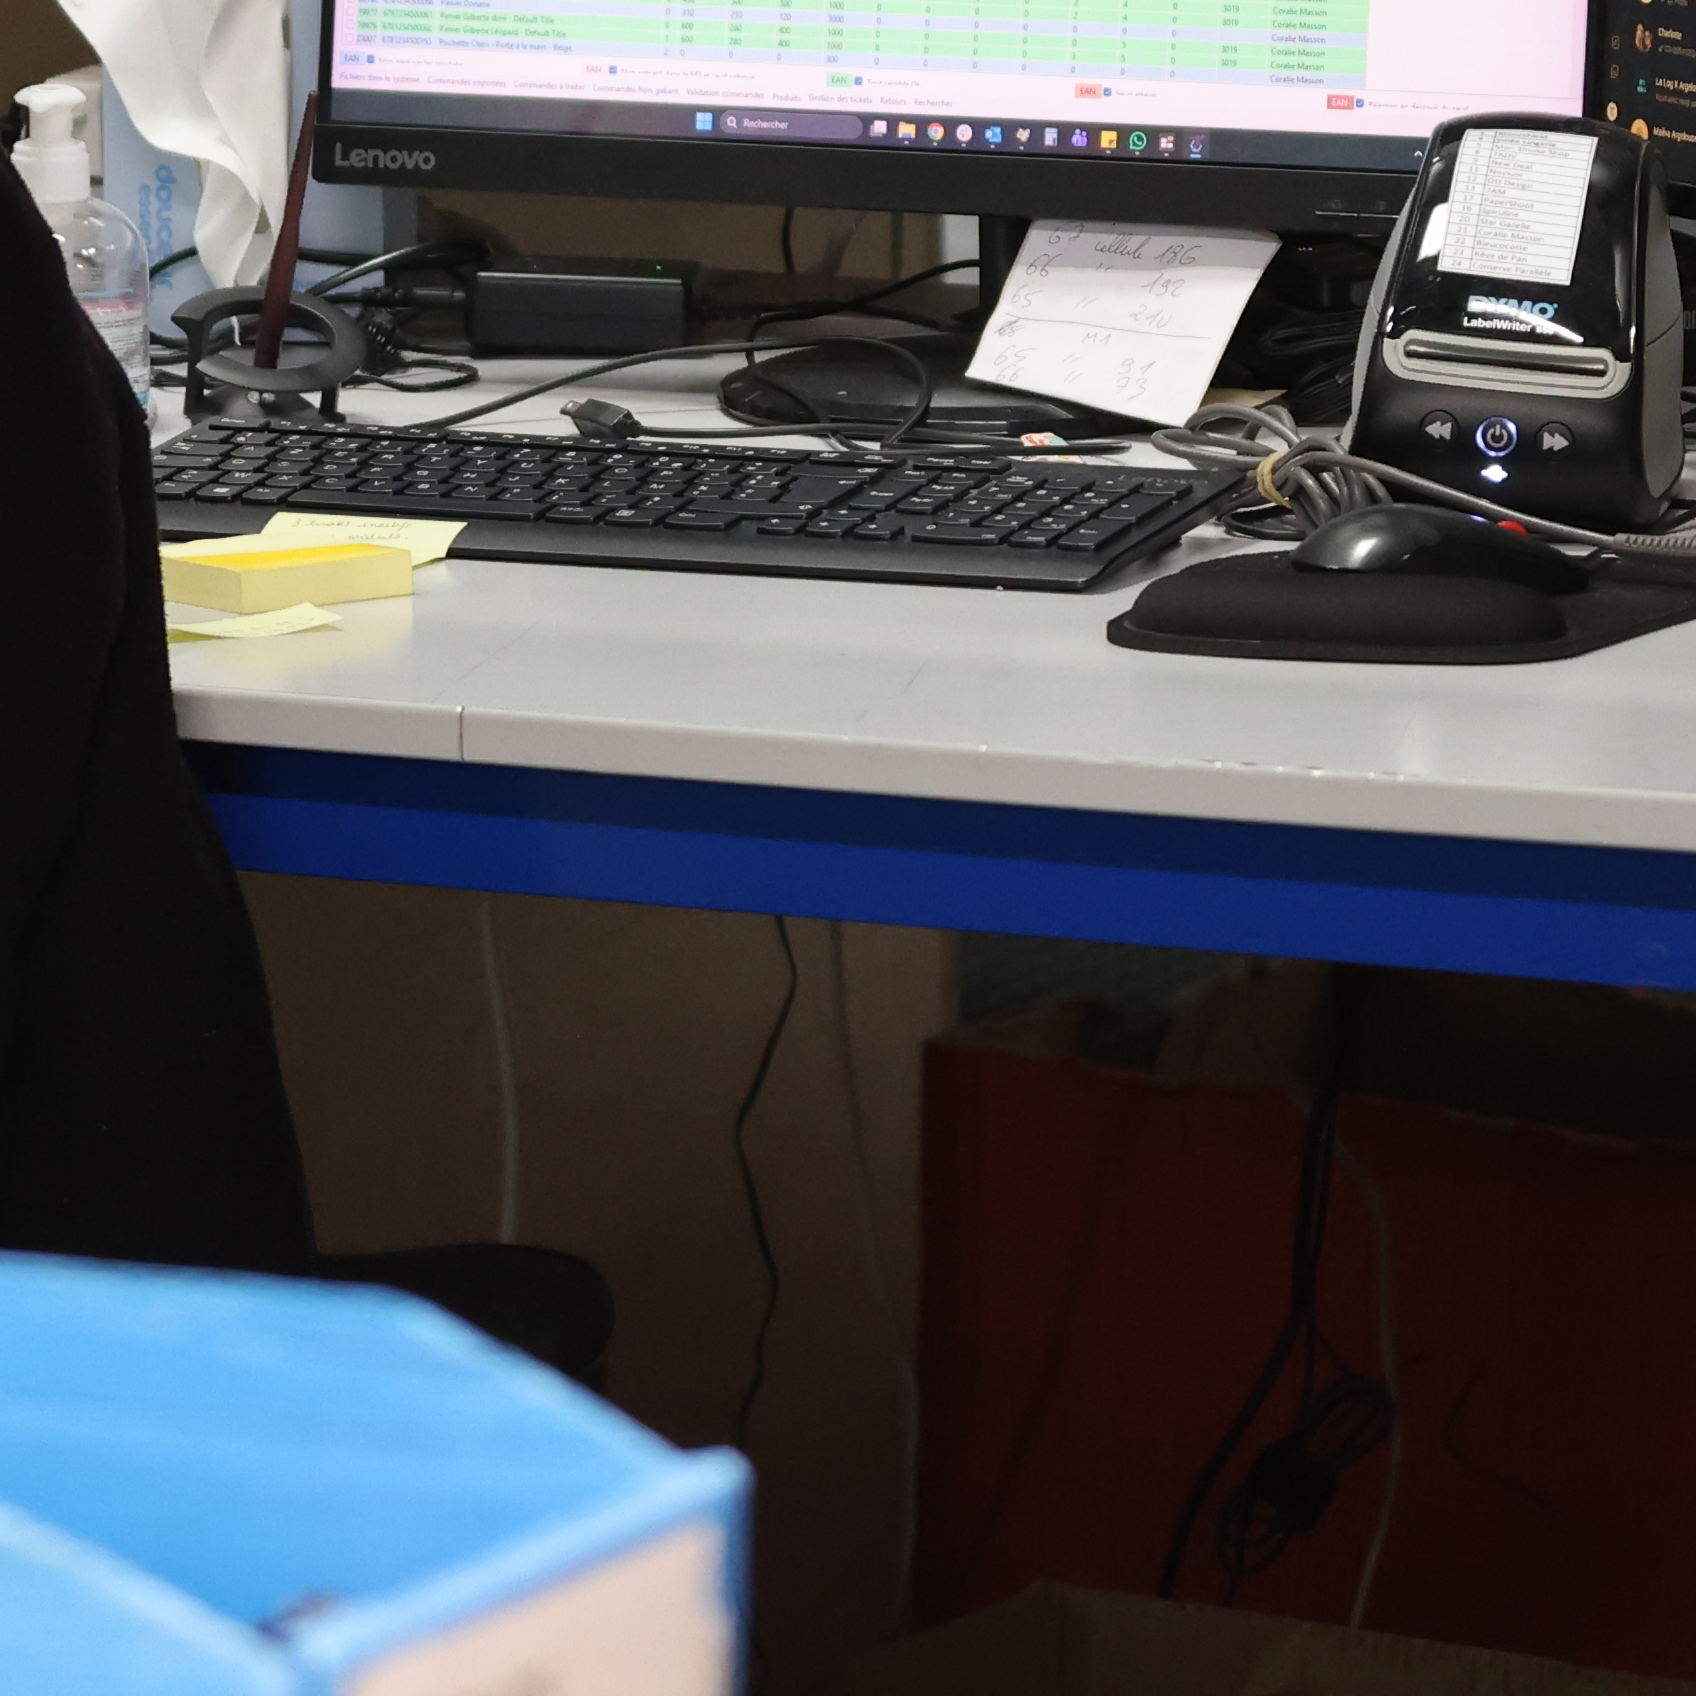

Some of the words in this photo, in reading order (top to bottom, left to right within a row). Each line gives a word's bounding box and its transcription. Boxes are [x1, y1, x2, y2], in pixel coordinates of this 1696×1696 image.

[743, 118, 789, 130] Rechercher
[334, 142, 436, 170] Lenovo
[1505, 180, 1533, 189] Design
[1459, 215, 1470, 223] 20
[1480, 218, 1497, 226] Star
[1499, 221, 1531, 230] Gazelle
[1457, 226, 1468, 234] 21
[1478, 228, 1509, 238] Coralie
[1511, 232, 1544, 243] Masson
[1476, 239, 1528, 252] Bleucocotte
[1026, 253, 1062, 277] 66
[1451, 259, 1462, 267] 24
[1472, 262, 1512, 272] Conserve
[1498, 253, 1509, 261] de
[1511, 255, 1527, 263] Pan
[1011, 283, 1042, 308] 65
[1467, 295, 1555, 320] DYMO
[1463, 316, 1532, 332] LabelWriter
